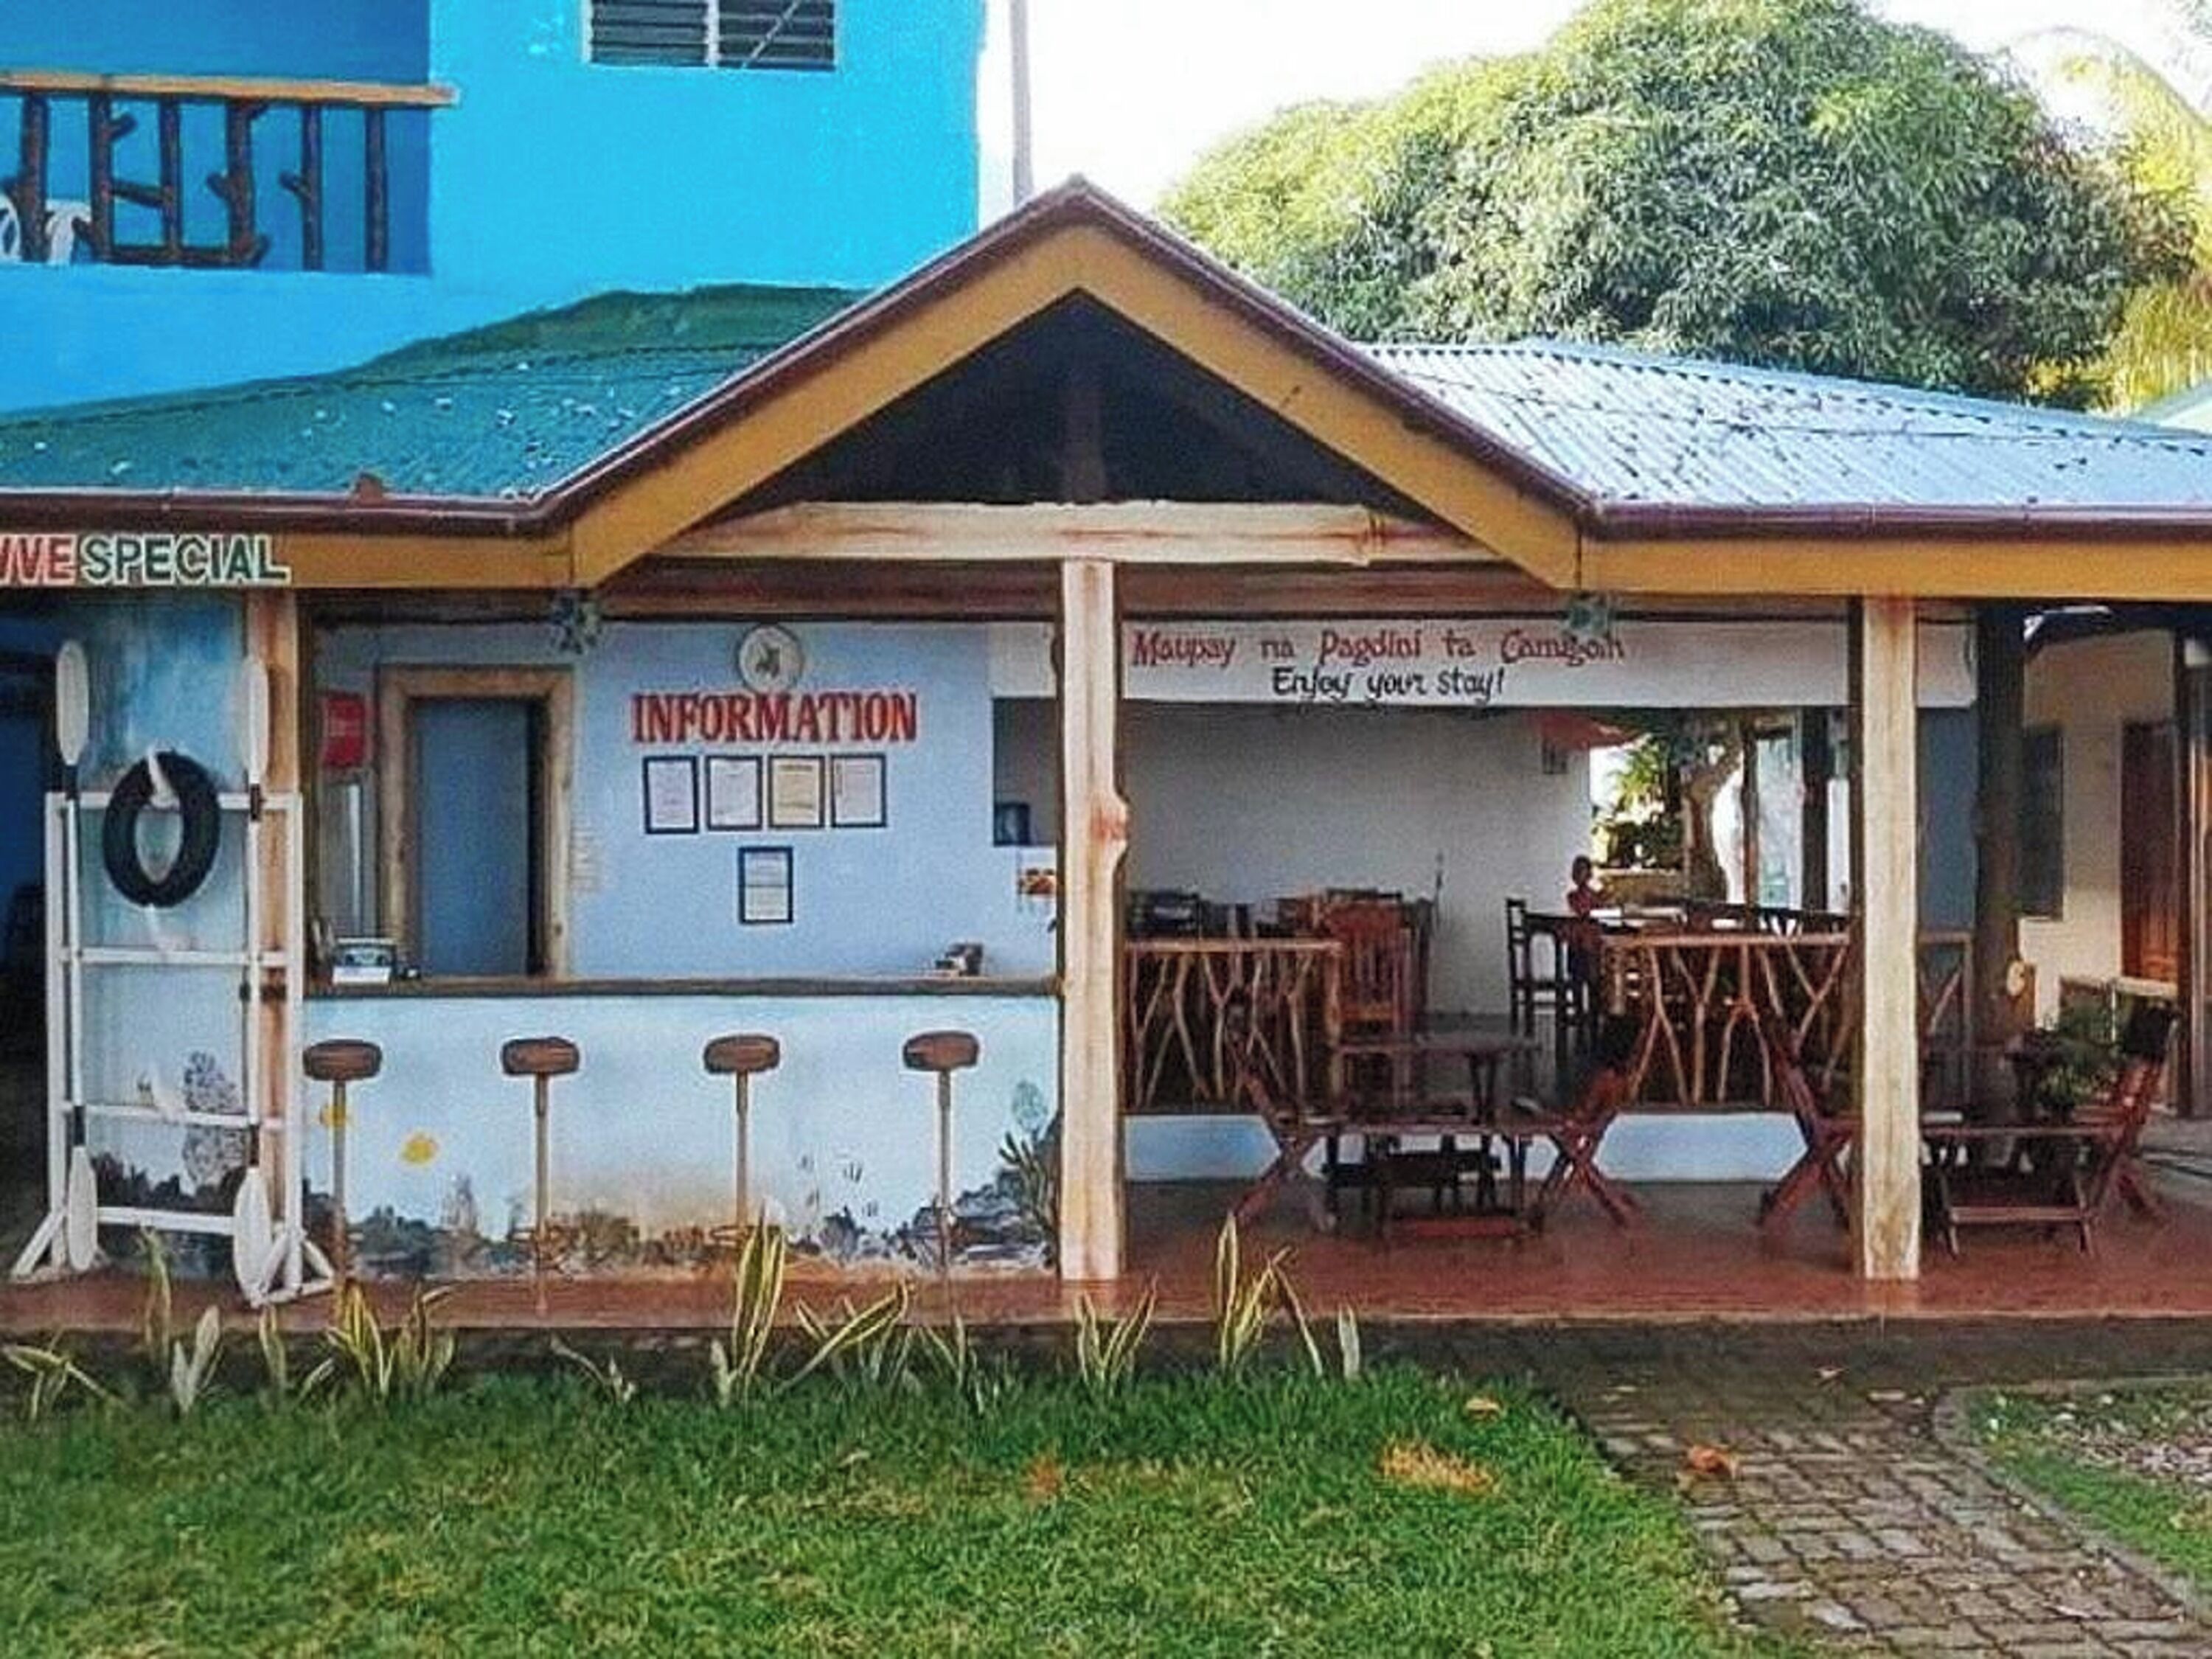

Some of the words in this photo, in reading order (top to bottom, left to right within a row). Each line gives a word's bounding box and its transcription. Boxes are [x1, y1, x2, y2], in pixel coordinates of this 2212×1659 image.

[79, 532, 293, 588] SPECIAL
[1132, 628, 1237, 667] Maupay
[1259, 637, 1296, 659] na
[1271, 665, 1352, 698] Enjoy
[1366, 669, 1428, 699] your
[1437, 665, 1504, 704] stay!
[631, 692, 918, 742] INFORMATION
